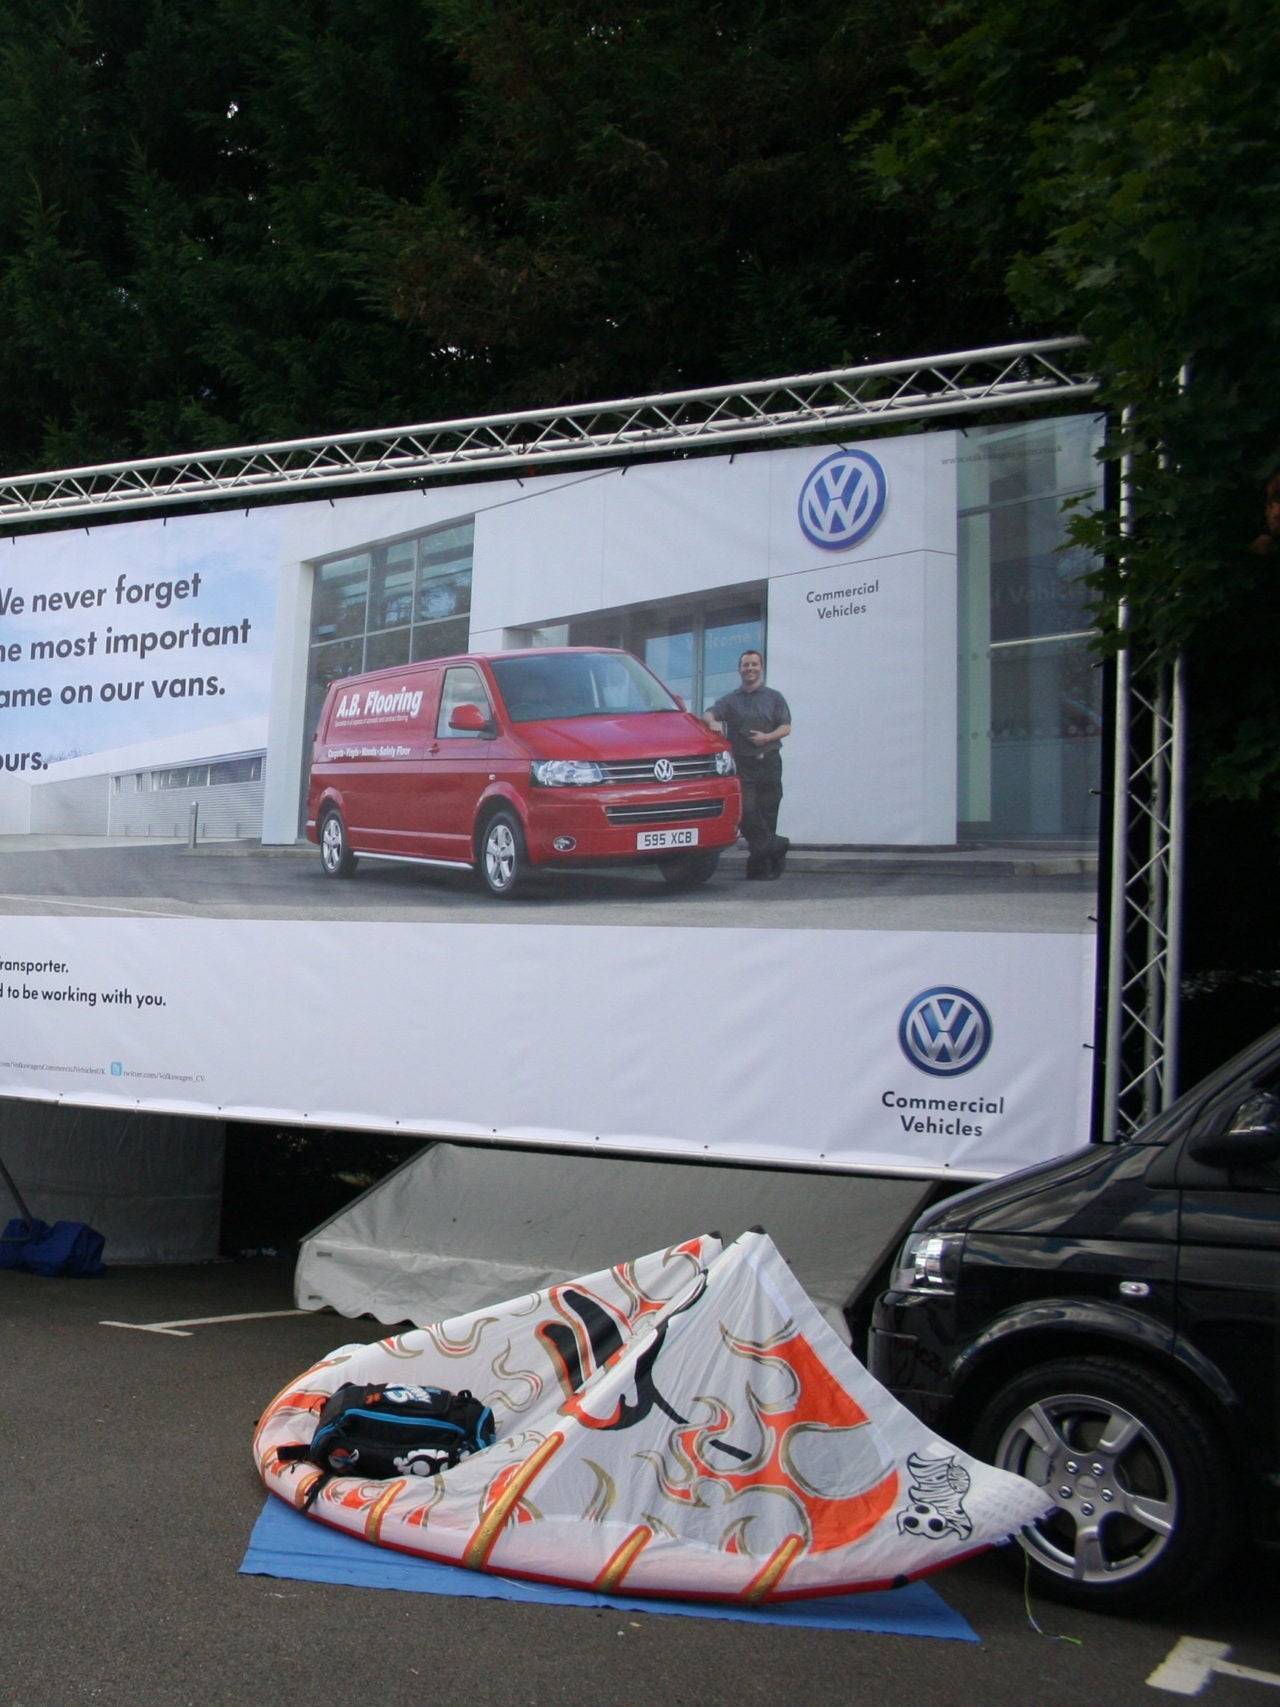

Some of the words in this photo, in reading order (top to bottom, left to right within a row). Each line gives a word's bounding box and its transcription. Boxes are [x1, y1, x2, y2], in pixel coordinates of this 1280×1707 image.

[32, 587, 107, 612] never
[115, 573, 201, 609] forget
[806, 580, 879, 603] Commercial
[817, 603, 867, 620] Vehicles
[30, 631, 97, 659] most
[105, 618, 251, 659] important
[61, 685, 93, 704] on
[100, 681, 144, 703] our
[151, 676, 226, 699] vans.
[337, 694, 361, 717] A.B.
[364, 686, 424, 718] Flooring
[644, 833, 666, 848] 595
[670, 831, 693, 845] XCB
[7, 985, 19, 999] to
[22, 984, 38, 1000] be
[41, 987, 97, 1006] working
[101, 989, 133, 1005] with
[136, 993, 167, 1009] you.
[881, 1091, 1004, 1115] Commercial
[900, 1115, 983, 1137] Vehicles
